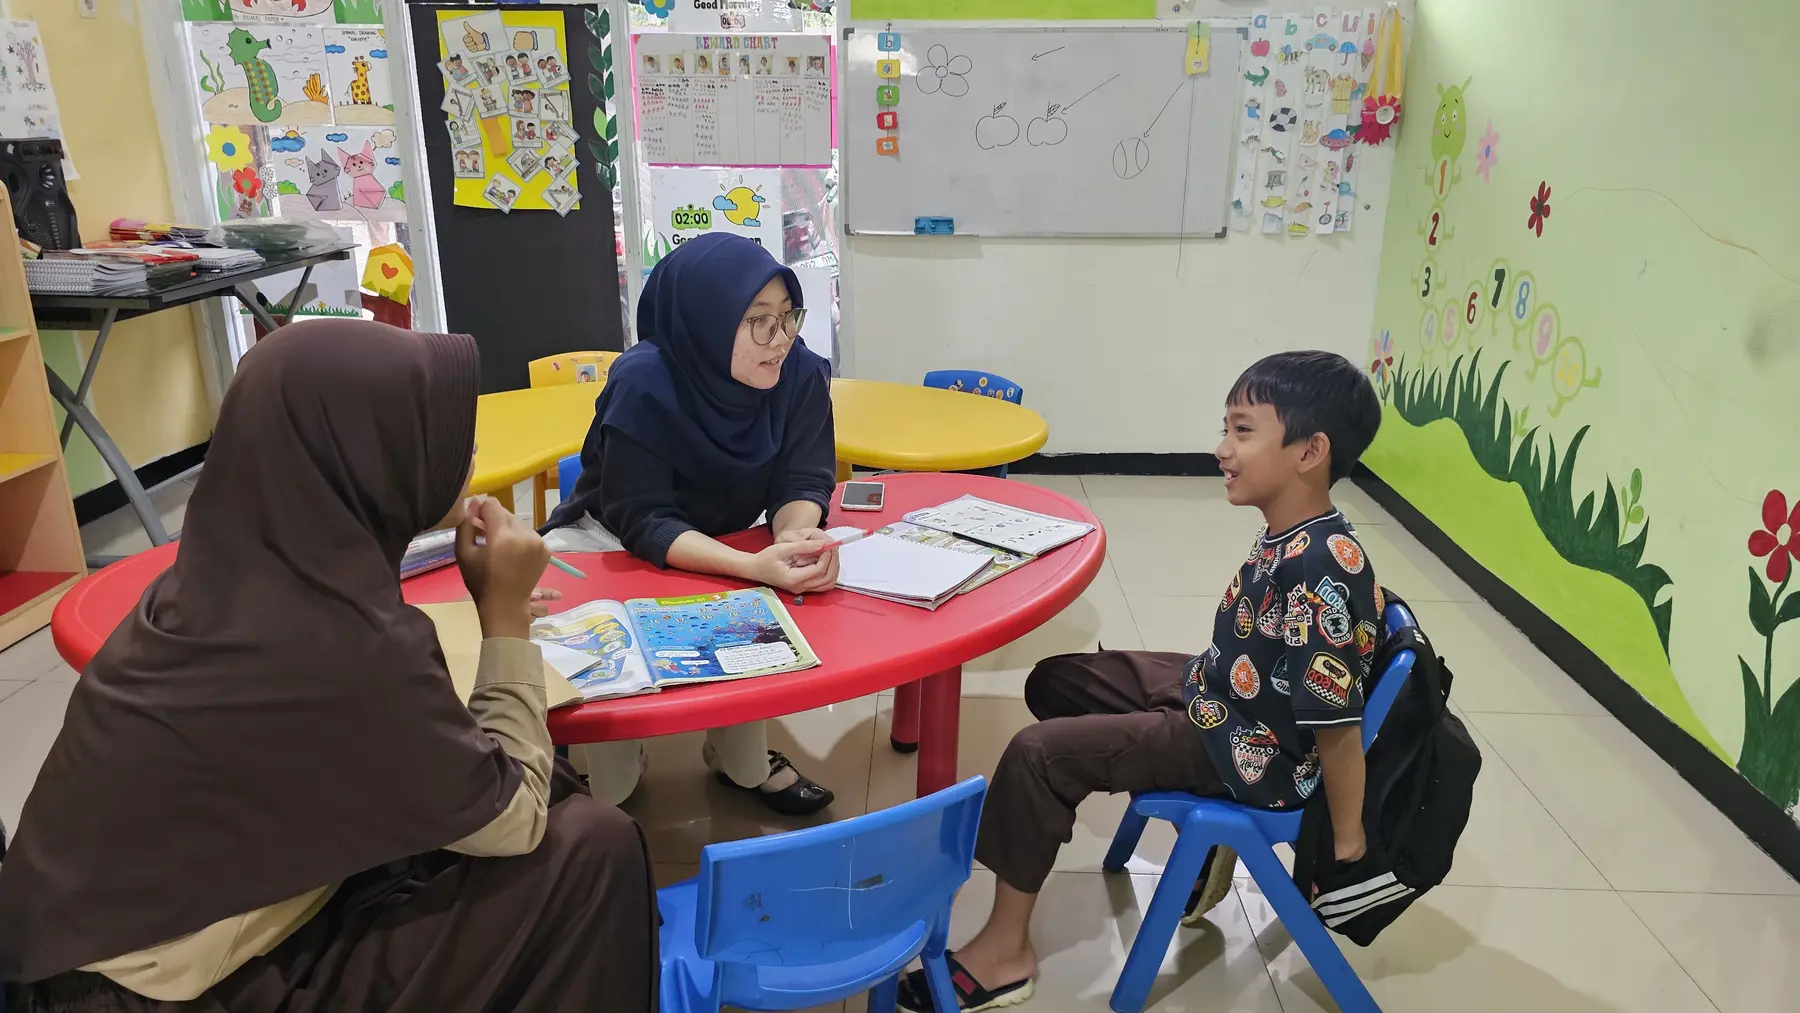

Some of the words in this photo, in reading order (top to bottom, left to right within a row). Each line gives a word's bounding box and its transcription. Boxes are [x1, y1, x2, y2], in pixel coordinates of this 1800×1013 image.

[694, 0, 718, 9] Good
[1254, 15, 1268, 29] a
[1285, 19, 1298, 36] b
[1367, 13, 1375, 35] i
[695, 36, 740, 50] REWARD
[743, 36, 778, 50] CHART
[885, 35, 893, 48] b
[1438, 160, 1447, 195] 1
[675, 212, 709, 225] 02:00
[1428, 212, 1440, 246] 2
[1422, 266, 1431, 297] 3
[1424, 313, 1434, 345] 4
[1443, 307, 1456, 342] 5
[1466, 291, 1478, 324] 6
[1491, 268, 1506, 309] 7
[1515, 280, 1530, 319] 8
[1536, 313, 1554, 356] 9
[1319, 585, 1346, 611] ROD
[1308, 668, 1332, 689] ROD
[1331, 679, 1347, 698] HOT
